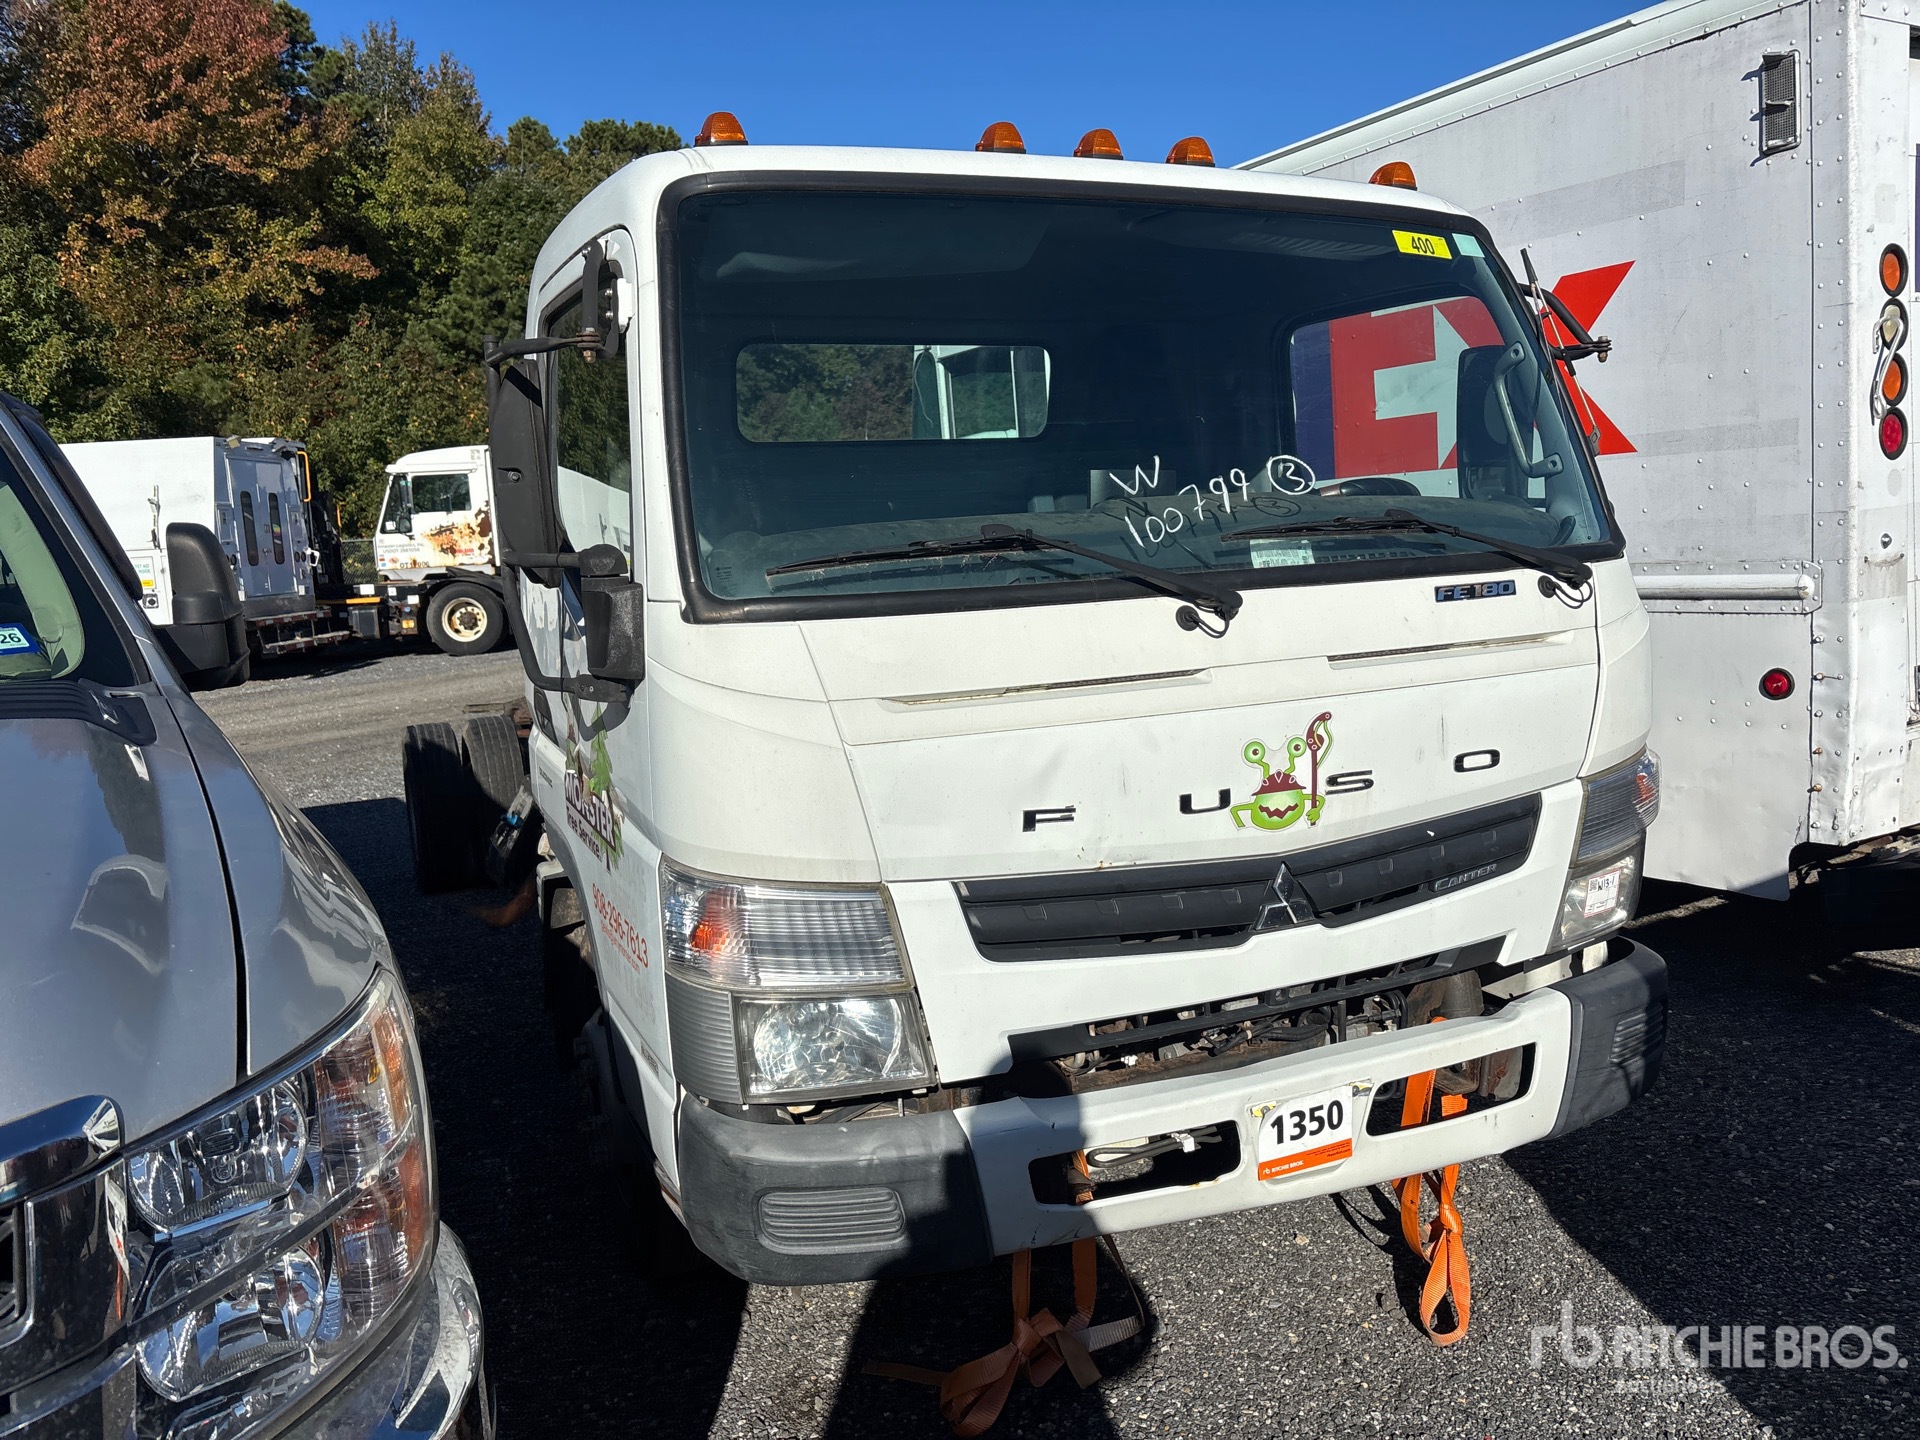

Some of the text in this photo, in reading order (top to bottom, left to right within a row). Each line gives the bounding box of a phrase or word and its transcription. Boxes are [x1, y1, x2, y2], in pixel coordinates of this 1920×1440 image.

[1411, 235, 1436, 255] 400
[1108, 454, 1160, 496] W
[1124, 467, 1250, 549] 100799
[1021, 748, 1501, 832] FUSO
[1270, 1099, 1344, 1145] 1350
